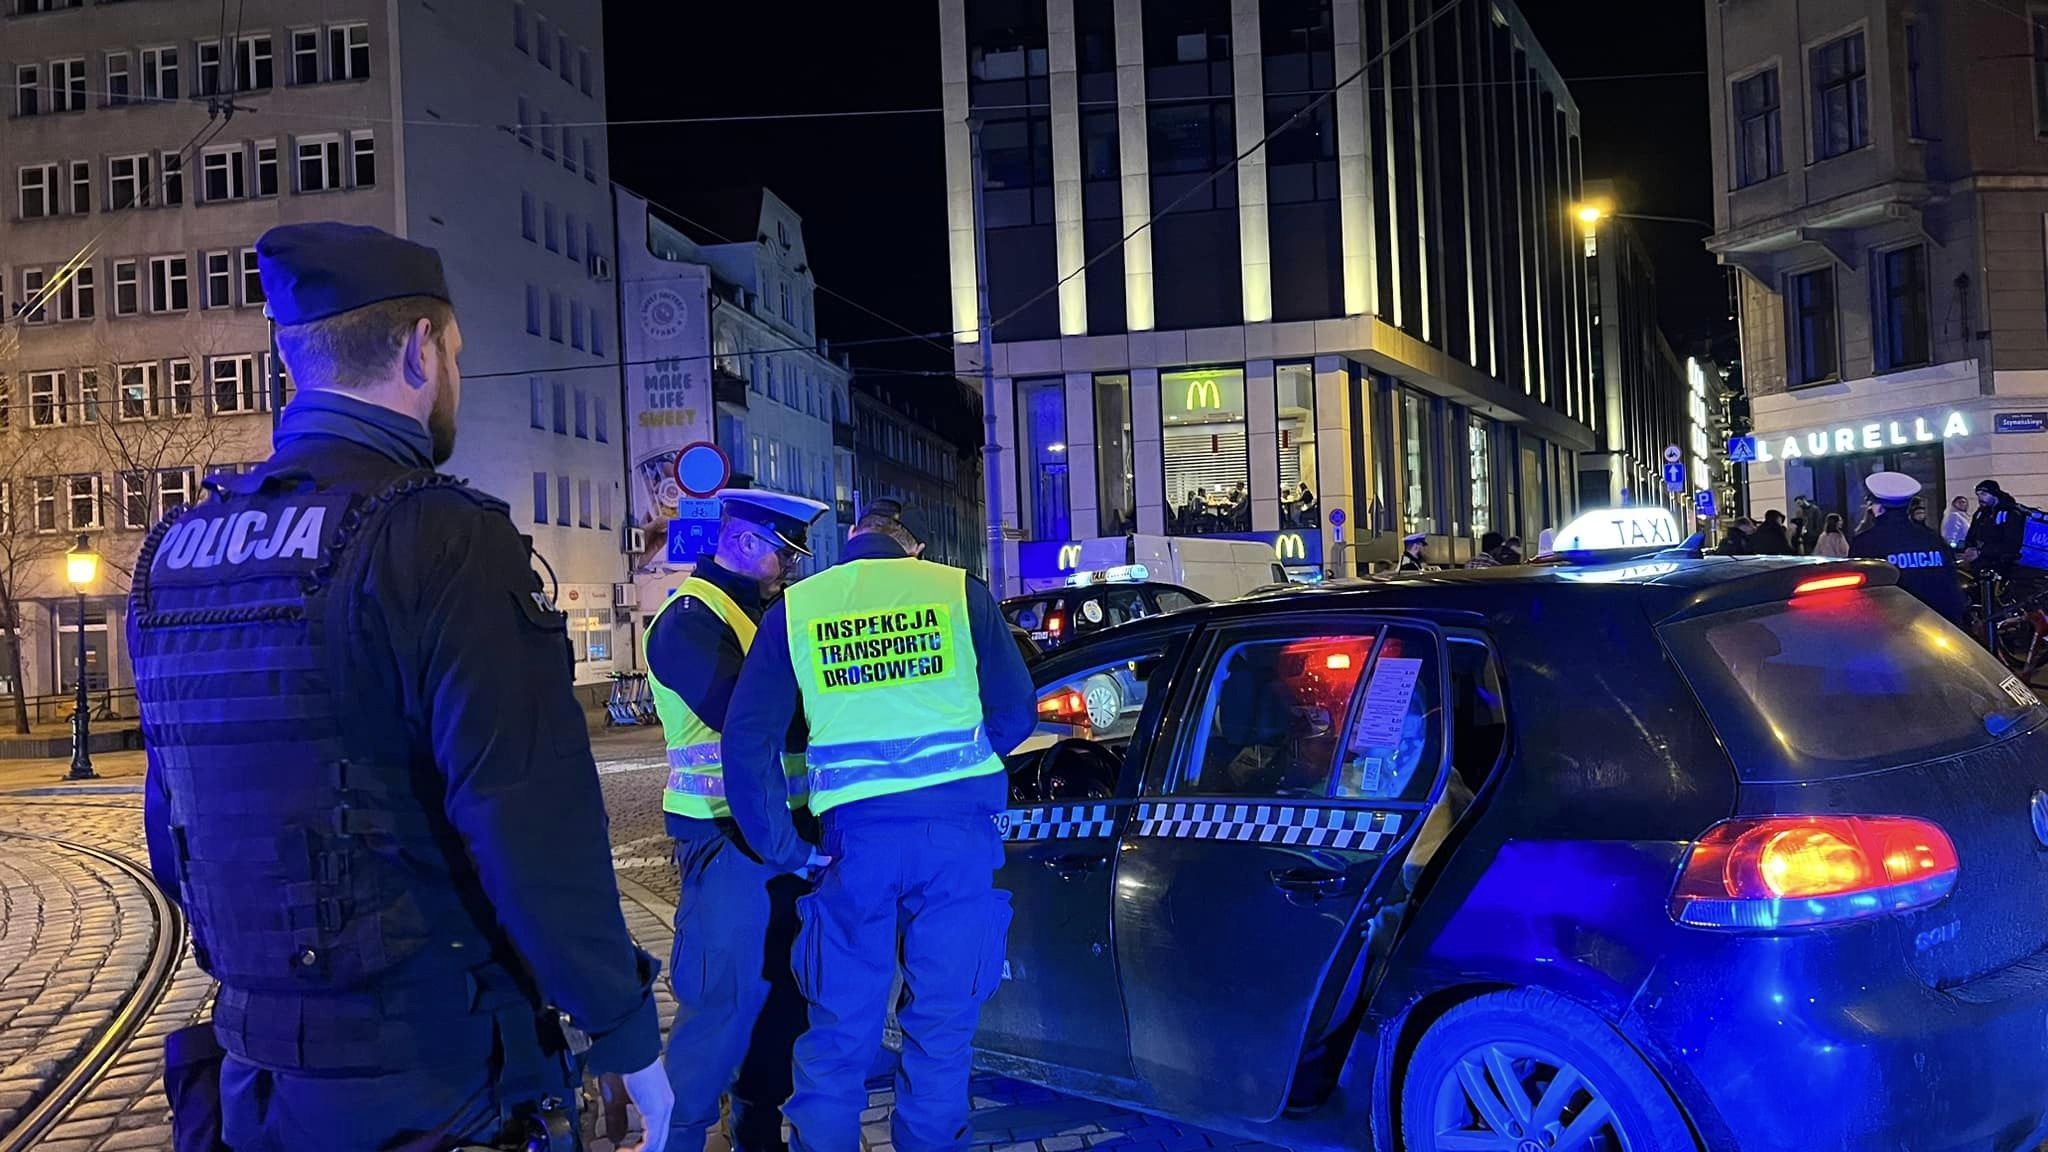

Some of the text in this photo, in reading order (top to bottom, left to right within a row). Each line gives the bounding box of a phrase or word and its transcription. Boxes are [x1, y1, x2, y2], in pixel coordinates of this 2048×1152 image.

[656, 355, 680, 372] WE
[644, 373, 692, 391] MAKE
[650, 391, 685, 409] LIFE
[639, 409, 696, 427] SWEET
[1757, 411, 1969, 462] LAURELLA
[151, 507, 326, 573] POLICJA
[1611, 518, 1673, 545] TAXI
[1887, 551, 1943, 569] POLICJA
[816, 608, 938, 642] INSPEKCJA
[818, 632, 942, 665] TRANSPORTU
[822, 655, 943, 688] DROGOWEGO
